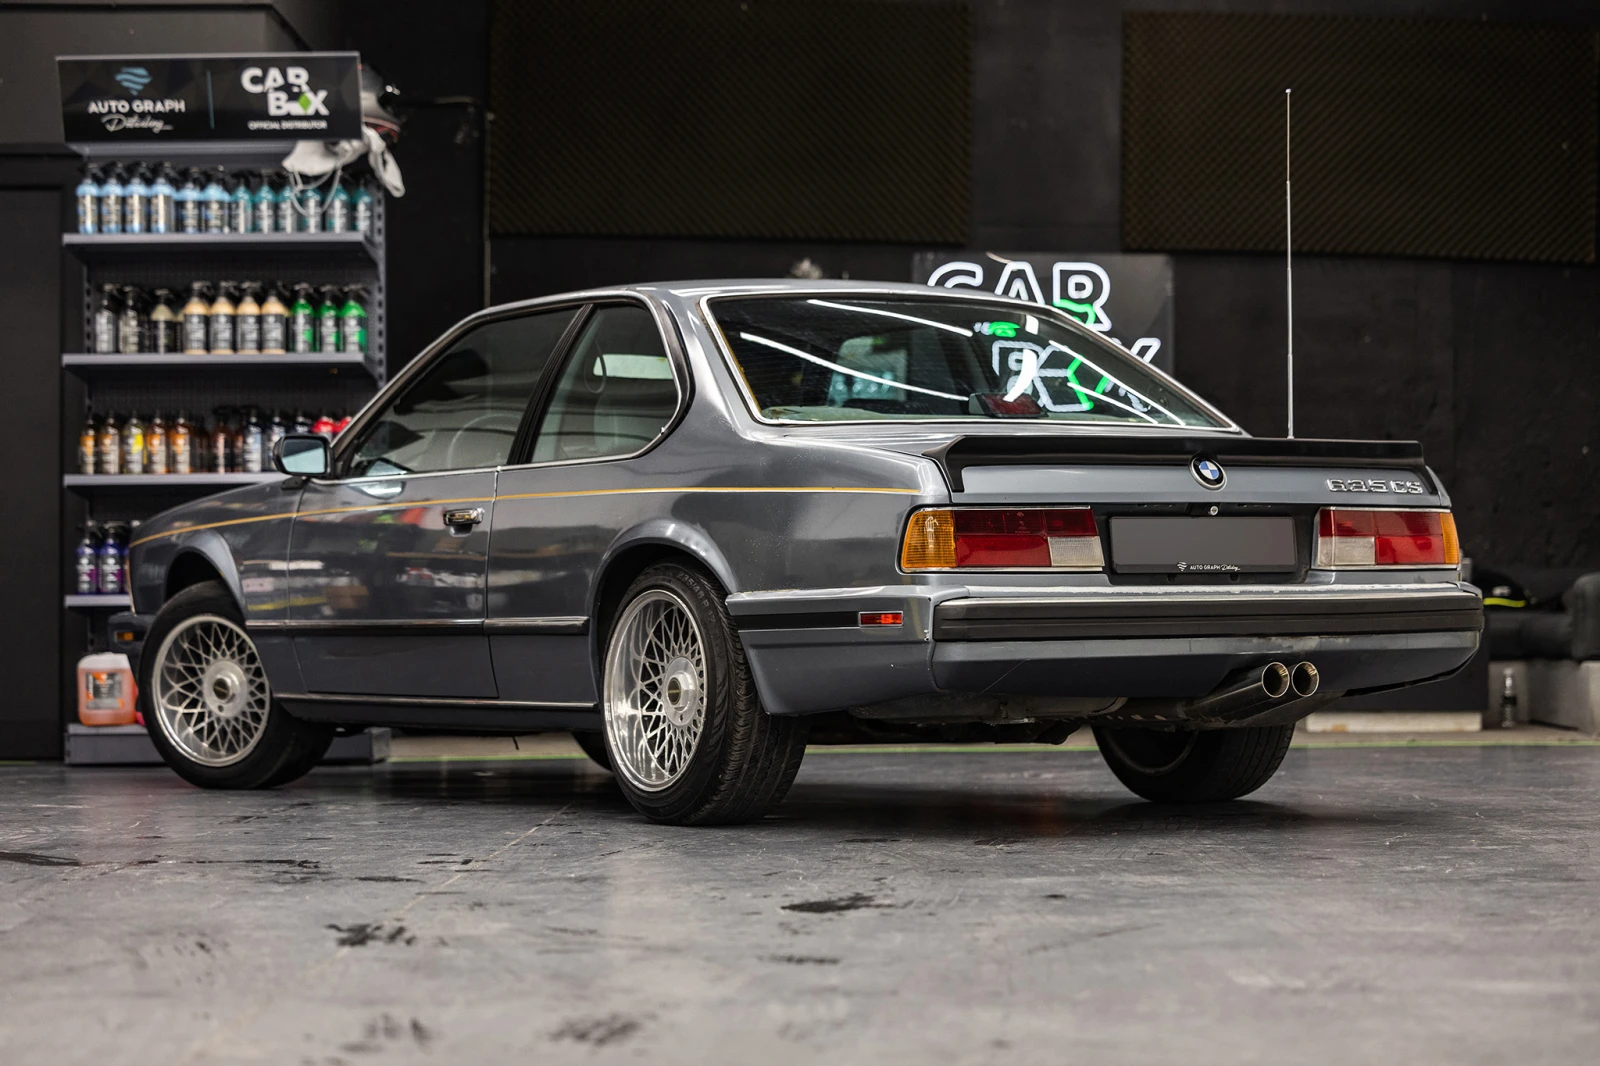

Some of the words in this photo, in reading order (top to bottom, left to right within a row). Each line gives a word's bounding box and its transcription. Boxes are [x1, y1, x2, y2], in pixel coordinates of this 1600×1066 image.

[240, 66, 310, 93] CAR
[87, 99, 130, 114] AUTO
[131, 98, 186, 113] GRAPH
[247, 120, 280, 130] OFFICIAL
[281, 120, 328, 130] DISTRIBUTOR
